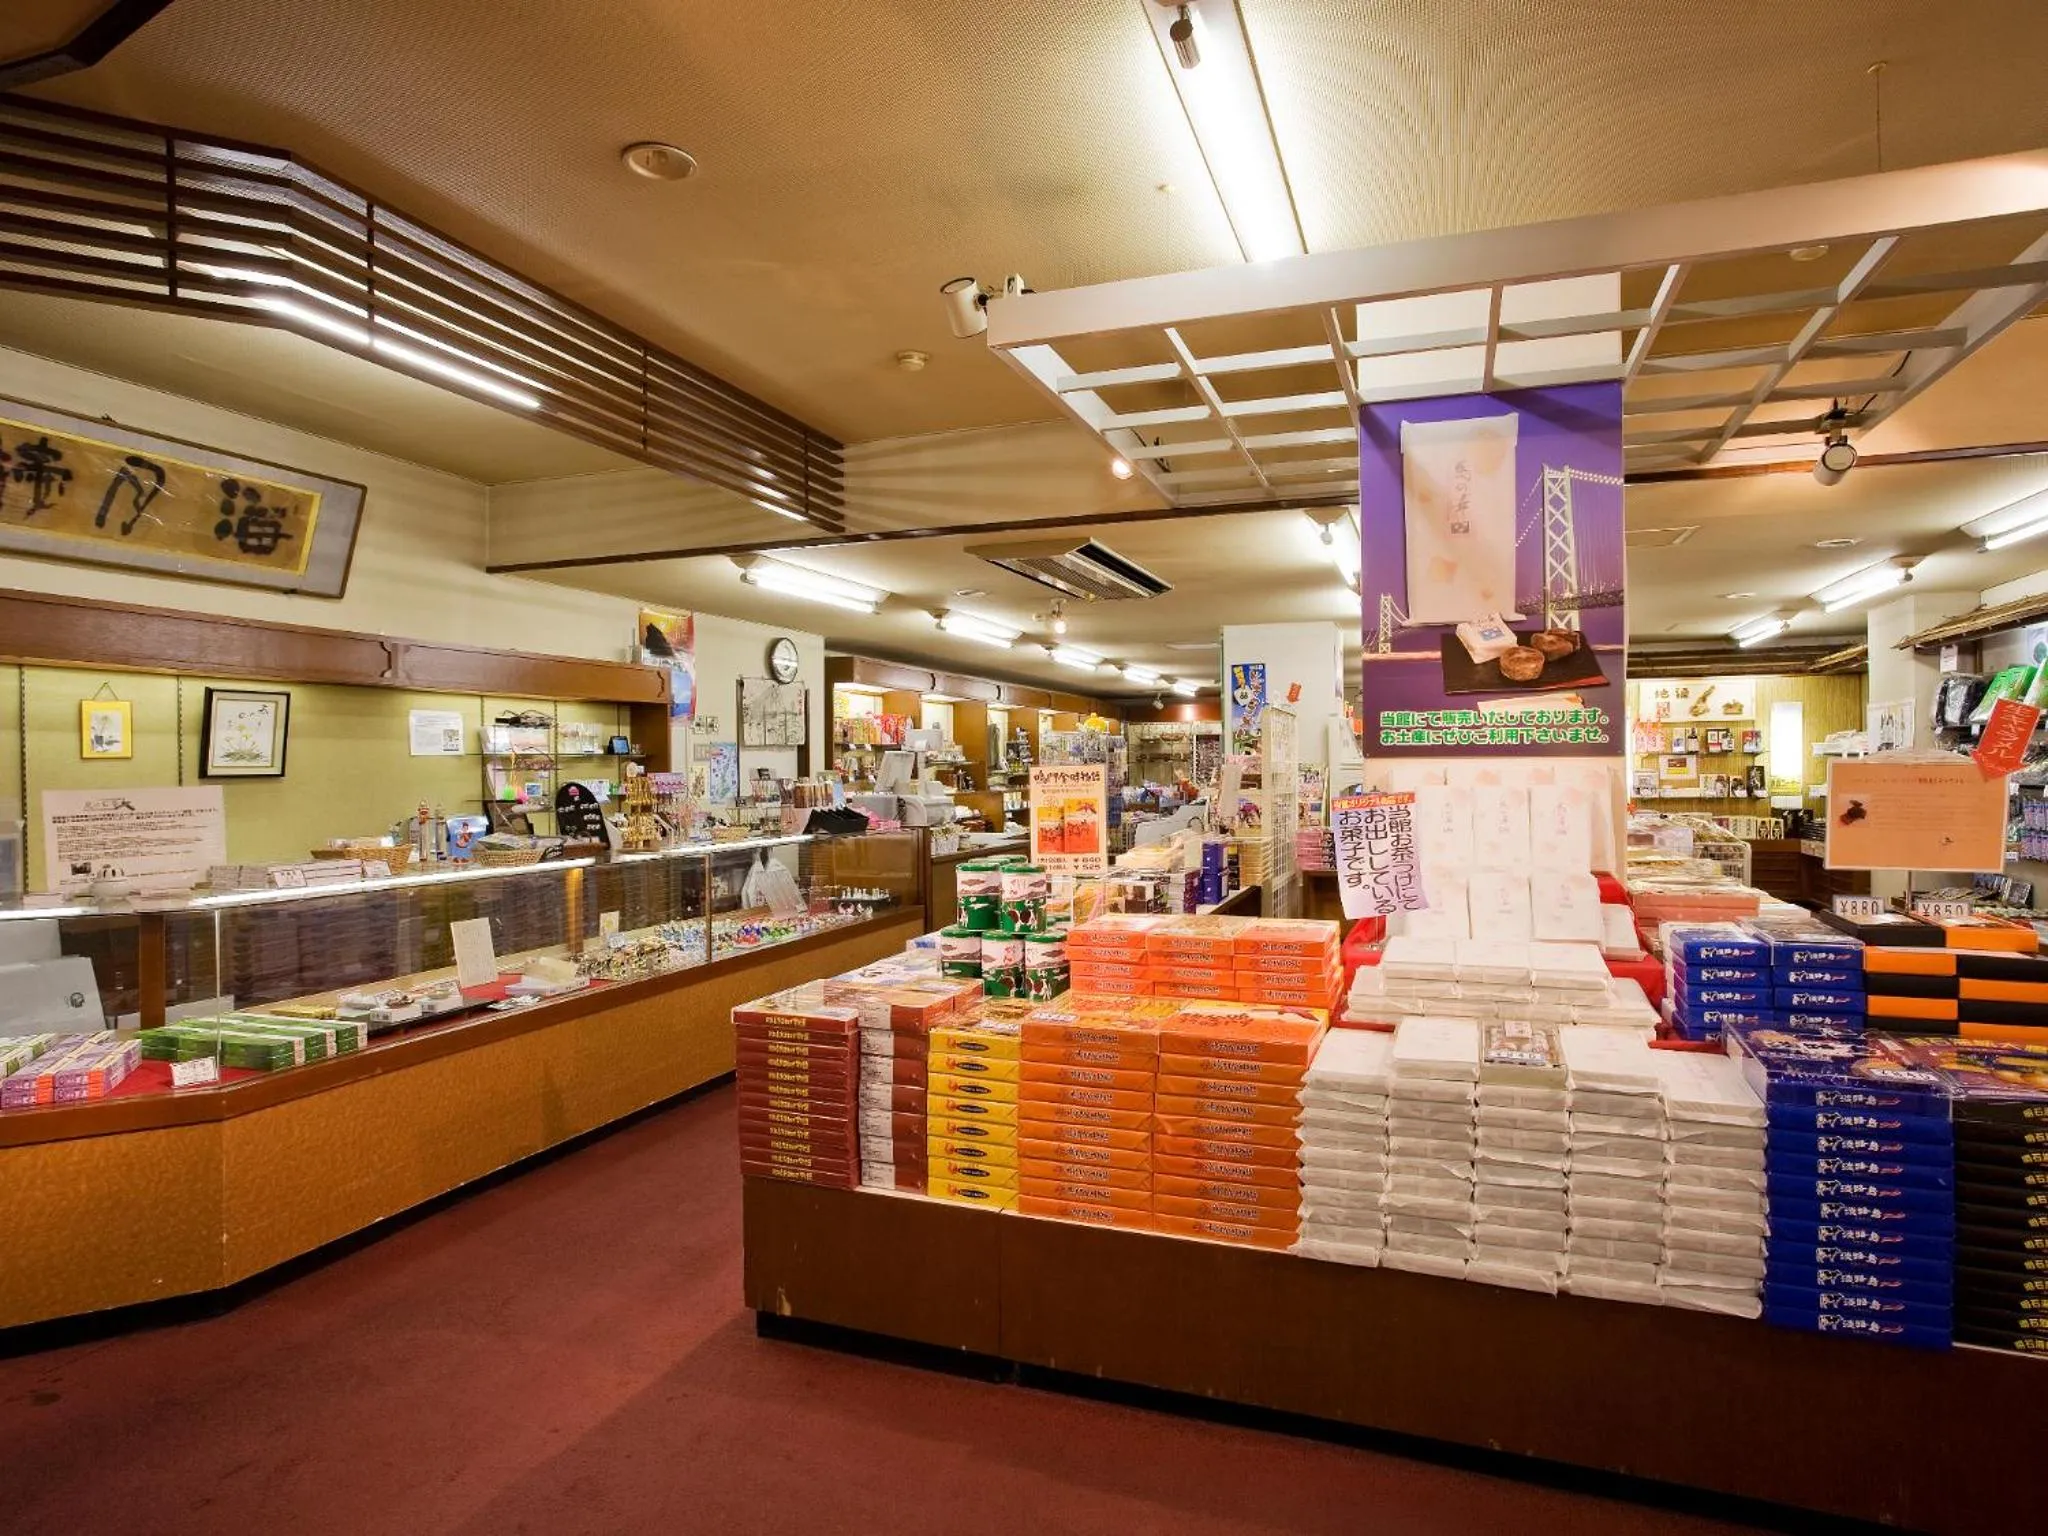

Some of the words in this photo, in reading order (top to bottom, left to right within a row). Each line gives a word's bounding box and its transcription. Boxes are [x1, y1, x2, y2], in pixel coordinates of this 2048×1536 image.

[1380, 708, 1609, 727] 当館にて販売いたしております。
[1380, 728, 1609, 746] お土産にぜひご利用下さいませ。
[1339, 810, 1370, 890] お菓子です。
[1364, 808, 1397, 914] お出ししている
[1840, 900, 1879, 915] ¥880
[1922, 904, 1964, 916] ¥850
